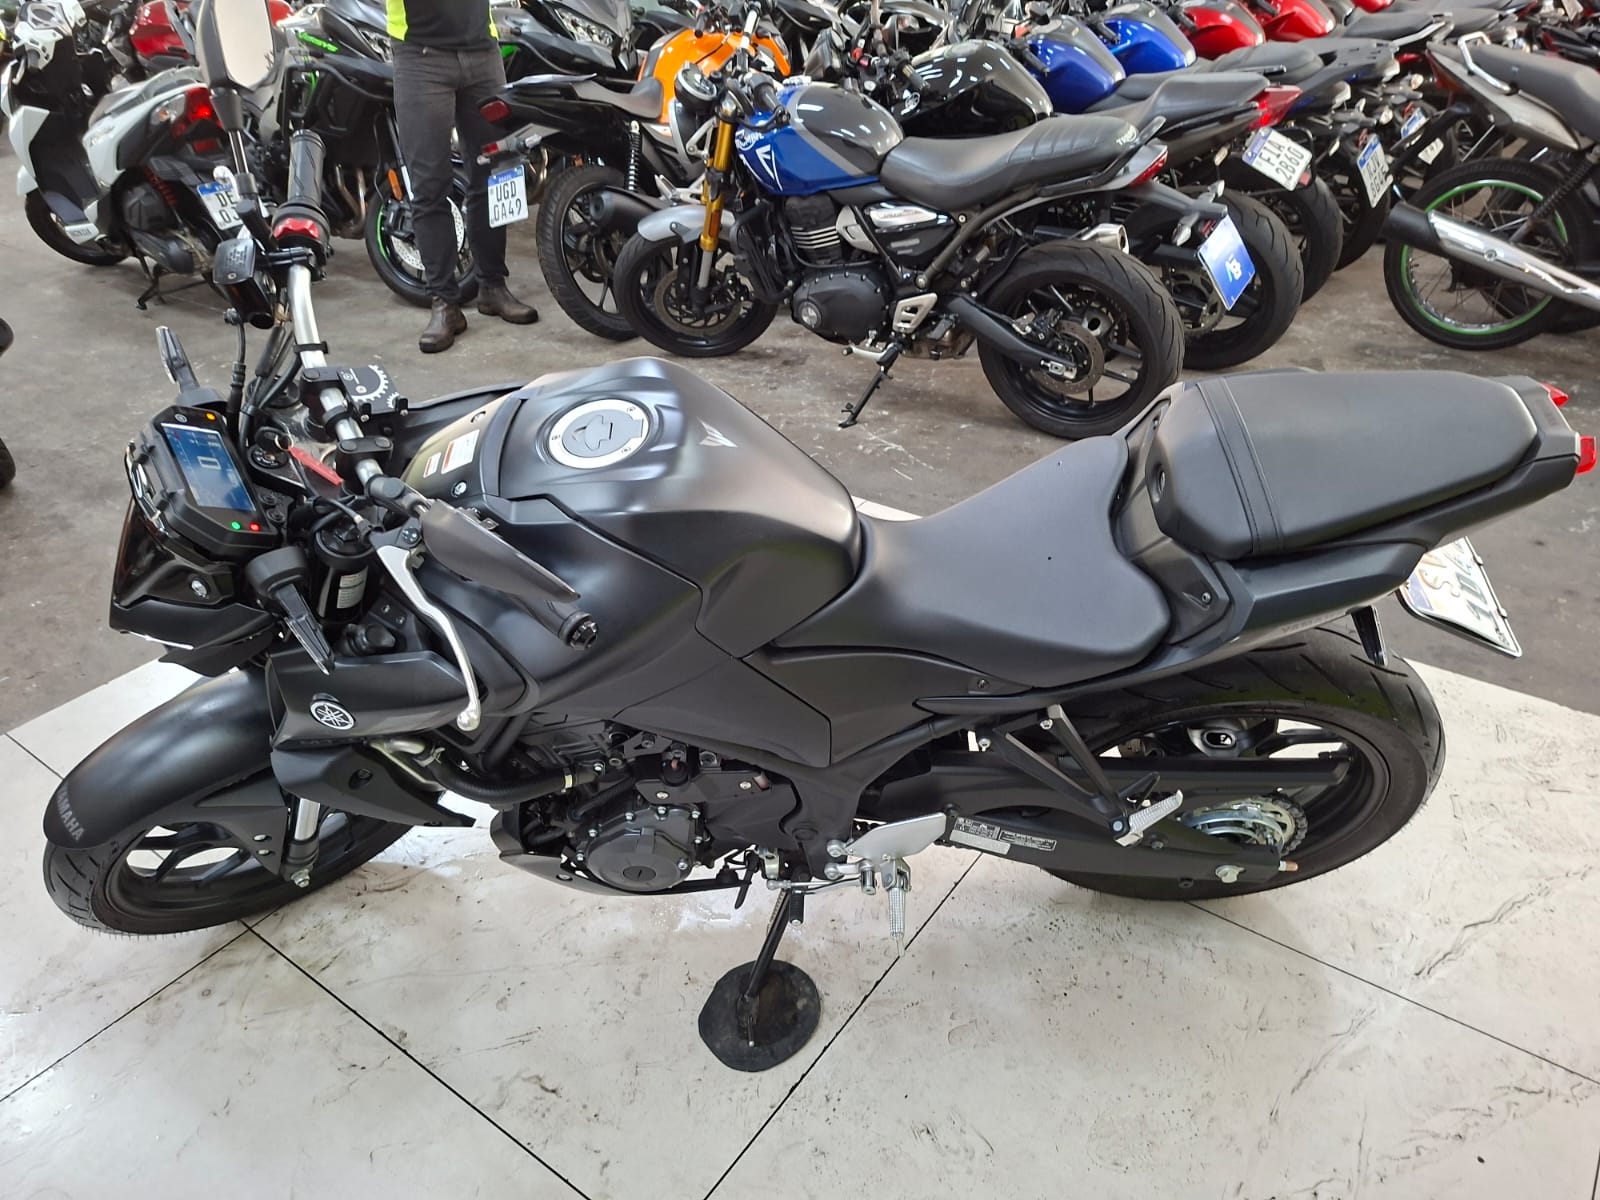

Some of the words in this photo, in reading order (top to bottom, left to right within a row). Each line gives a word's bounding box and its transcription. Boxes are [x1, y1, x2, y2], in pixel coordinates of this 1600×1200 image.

[215, 191, 238, 208] DE
[495, 180, 517, 202] UGD
[493, 198, 522, 222] 0A49
